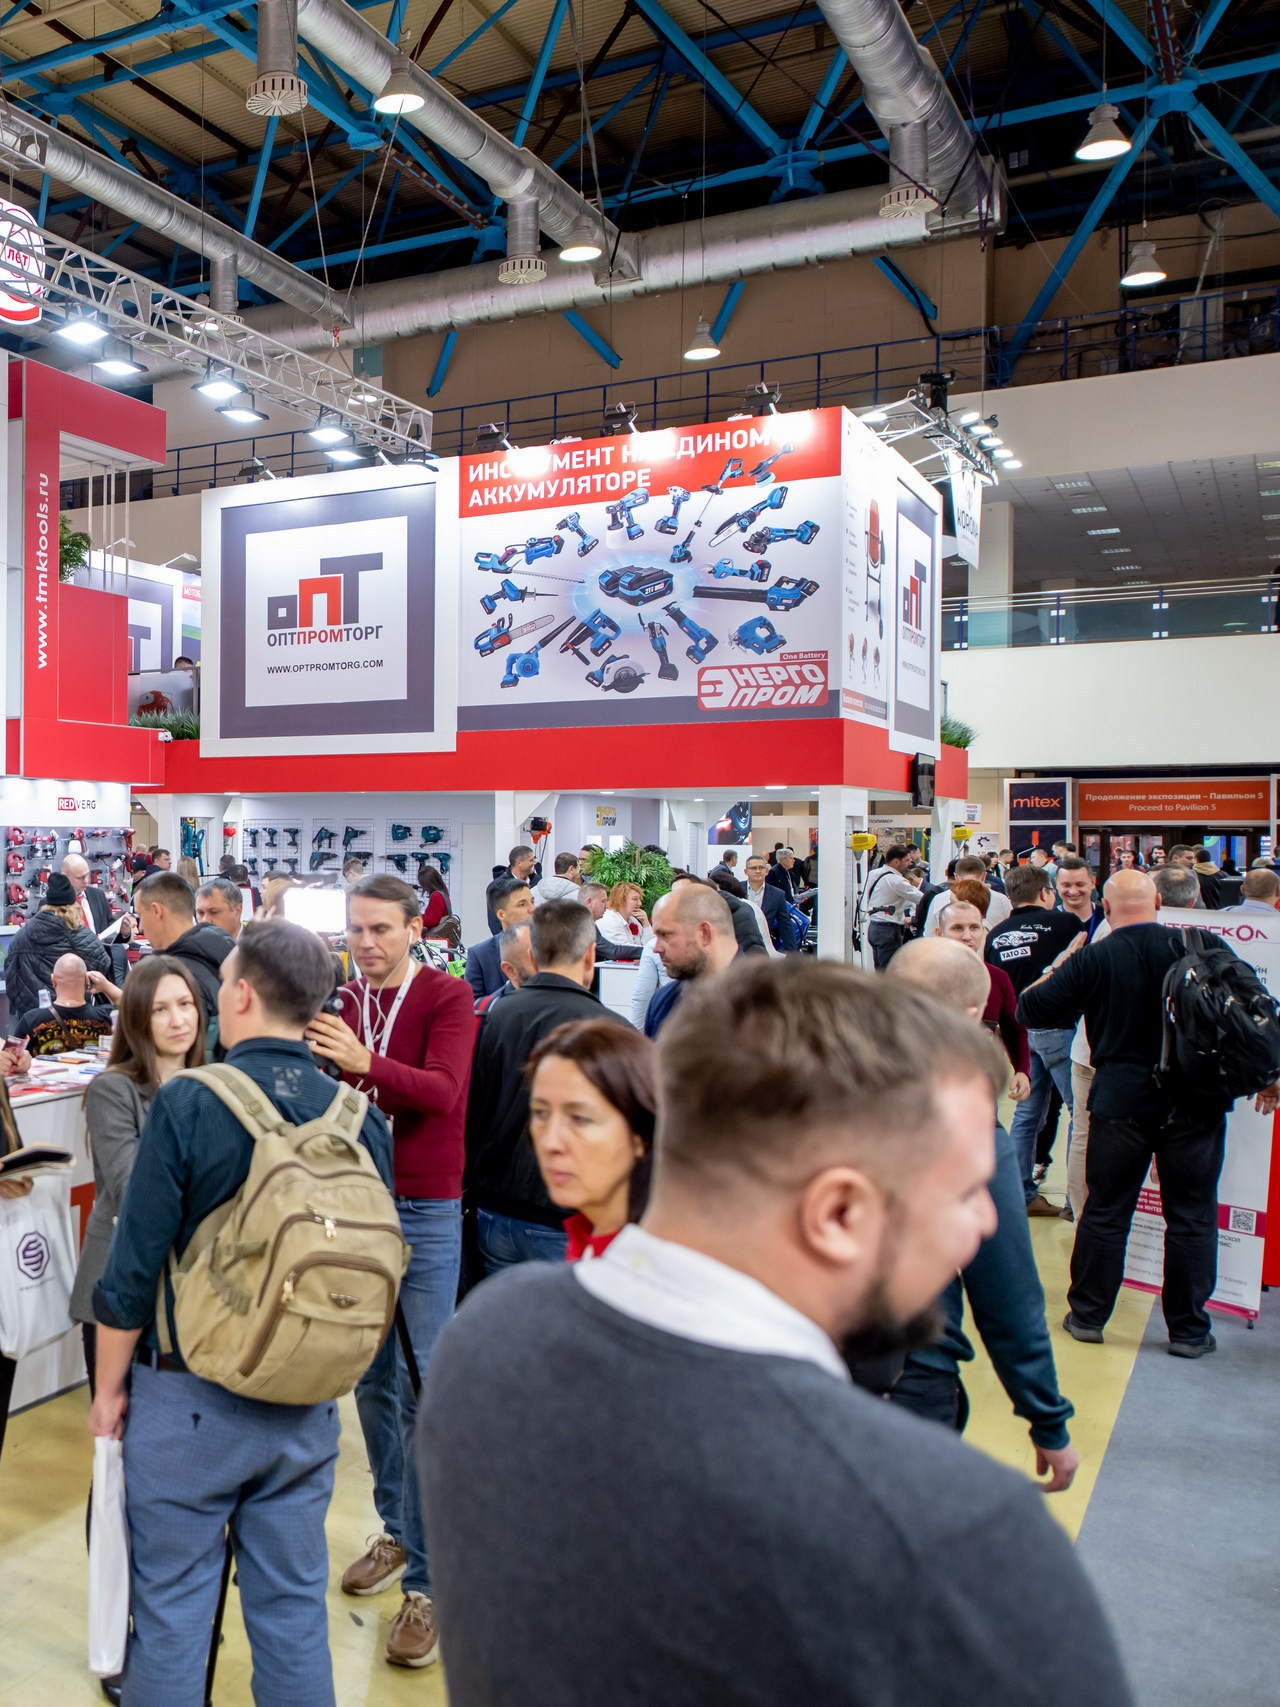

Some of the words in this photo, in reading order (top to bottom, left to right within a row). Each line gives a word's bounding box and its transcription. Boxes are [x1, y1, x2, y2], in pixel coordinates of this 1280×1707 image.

[661, 428, 770, 461] ДИНОМ
[468, 468, 651, 508] АККУМУЛЯТОРЕ
[35, 473, 49, 669] www.tmktools.ru
[267, 625, 383, 645] ОПТПРОМТОРГ
[798, 652, 826, 660] Battery
[267, 659, 384, 674] WWW.OPTPROMTORG.COM
[731, 684, 824, 707] ПРОМ
[1013, 796, 1061, 808] mitex
[1085, 793, 1146, 801] Продолжение
[1148, 793, 1201, 801] экспозиции
[1209, 792, 1256, 800] Павильон
[58, 797, 97, 811] REDVERG
[1128, 803, 1163, 811] Proceed
[1175, 803, 1209, 811] Pavilion
[1211, 803, 1217, 811] 5
[1001, 949, 1019, 959] YATO
